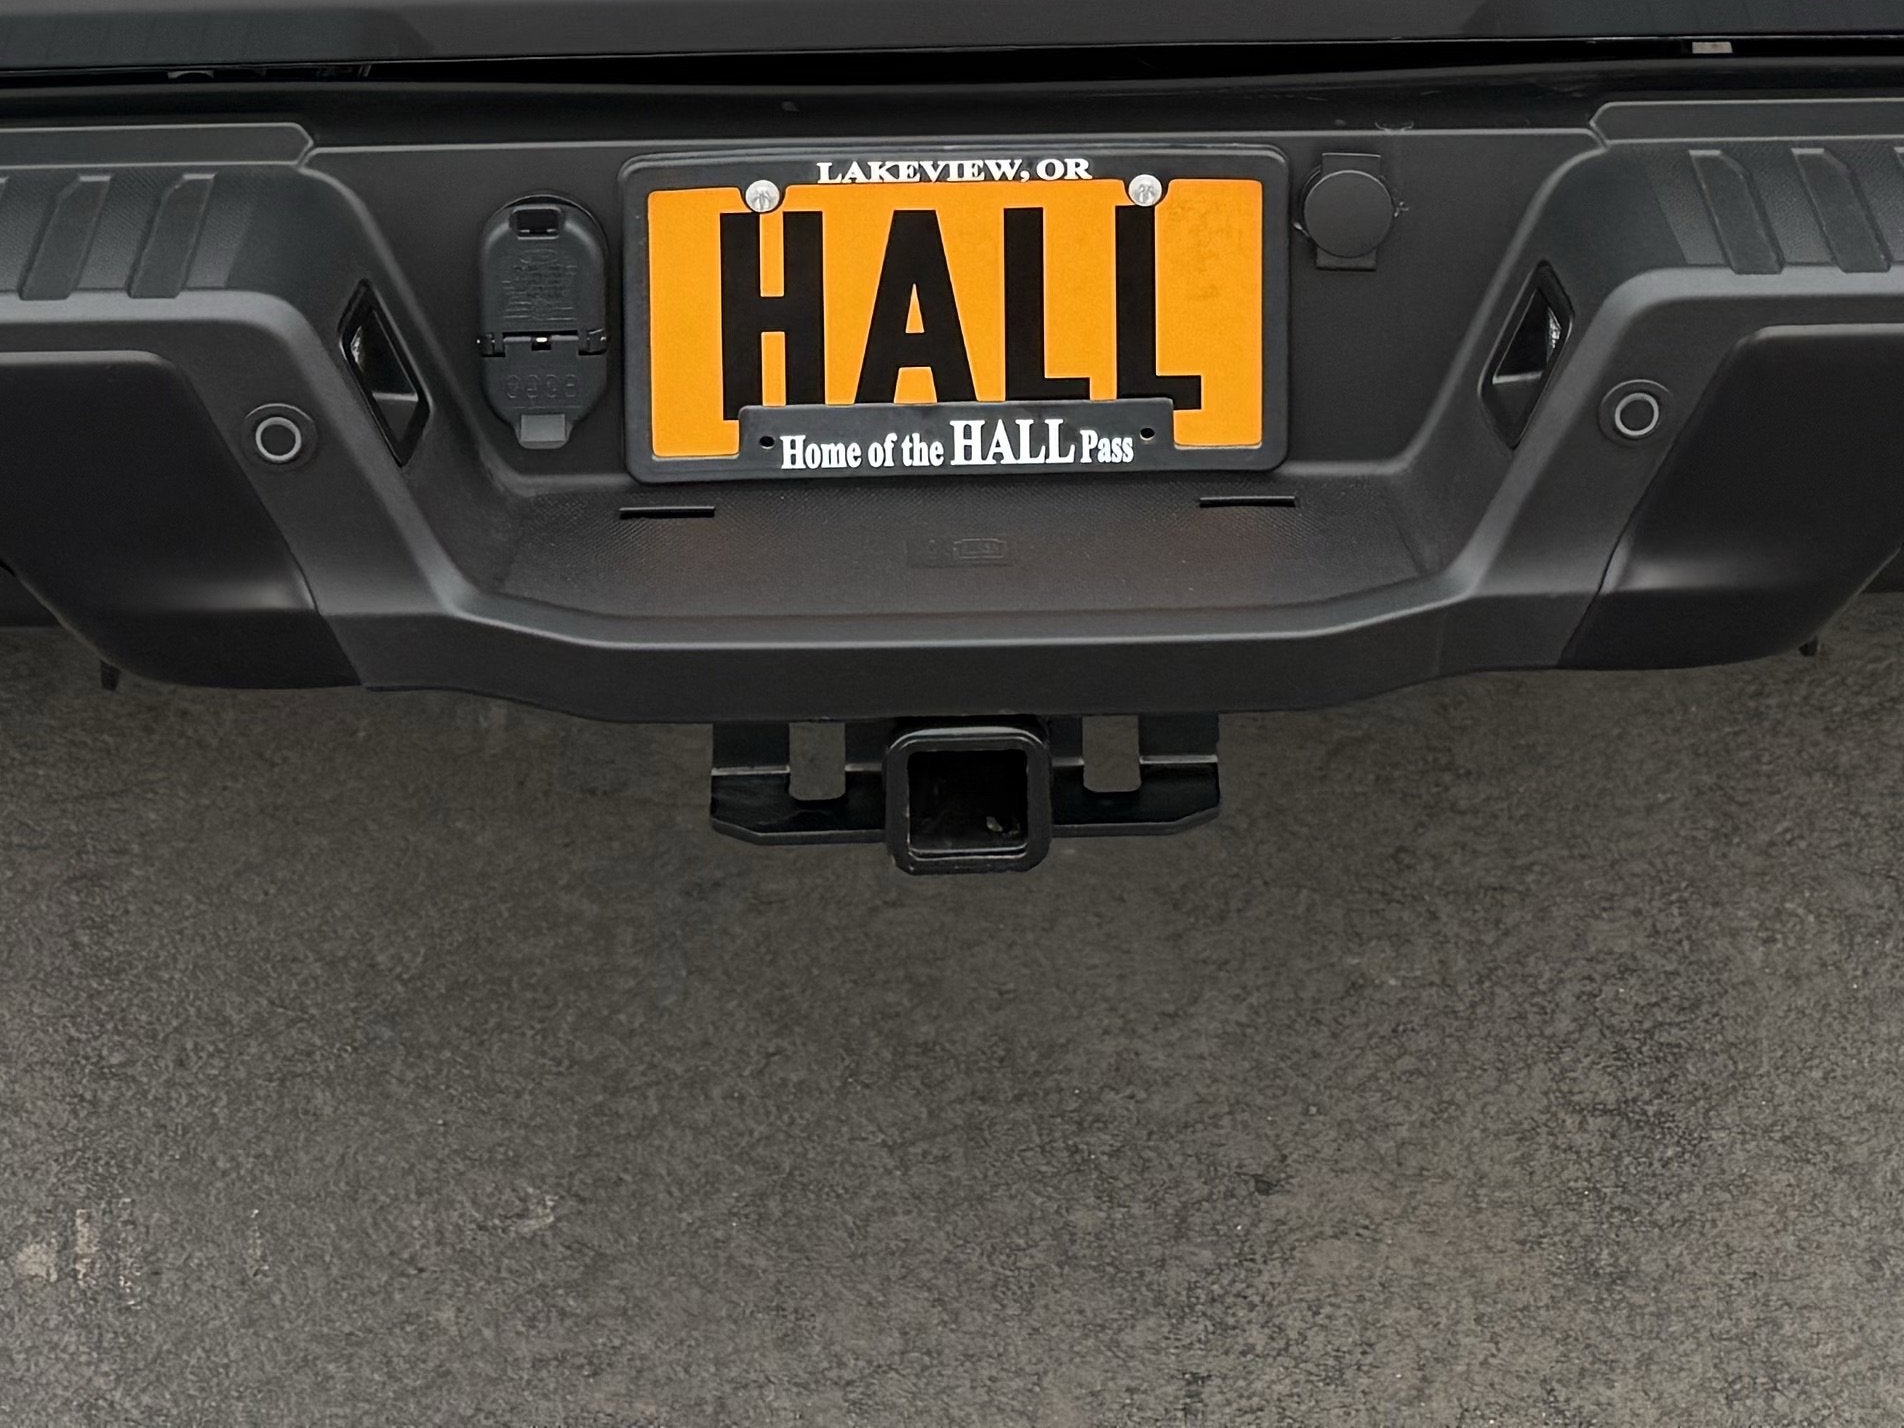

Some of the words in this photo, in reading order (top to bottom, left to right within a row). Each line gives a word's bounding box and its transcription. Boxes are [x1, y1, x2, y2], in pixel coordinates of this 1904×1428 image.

[817, 158, 1031, 185] LAKEVIEW,
[1035, 158, 1093, 182] OR
[720, 205, 1202, 421] HALL
[781, 434, 862, 471] Home
[867, 432, 897, 468] of
[900, 432, 945, 467] the
[949, 417, 1080, 467] HALL
[1080, 430, 1135, 465] Pass
